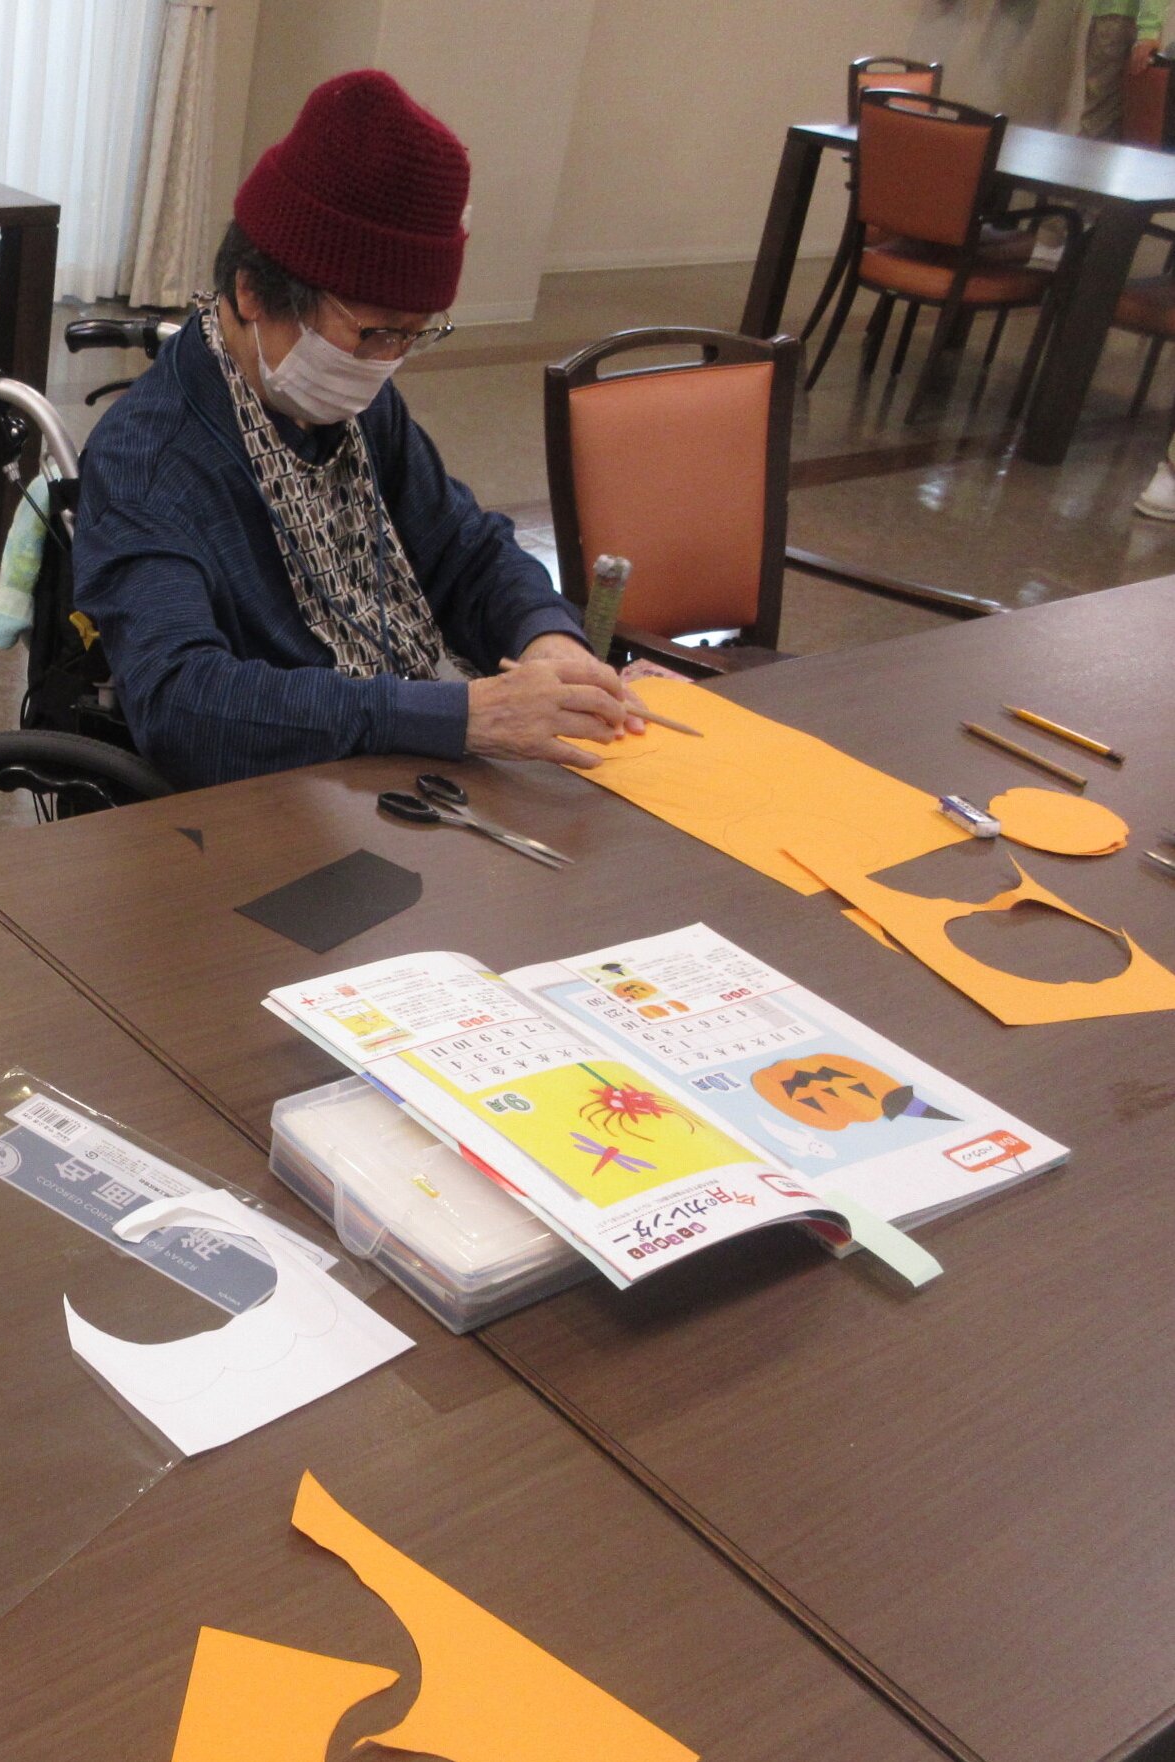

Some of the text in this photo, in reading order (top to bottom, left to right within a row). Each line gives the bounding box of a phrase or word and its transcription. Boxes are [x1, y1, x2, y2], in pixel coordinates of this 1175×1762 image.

[500, 1028, 515, 1037] 8
[524, 1024, 537, 1033] 7
[660, 1028, 674, 1037] 8
[679, 1024, 693, 1033] 7
[479, 1033, 493, 1043] 9
[642, 1032, 655, 1042] 9
[452, 1039, 473, 1050] 10
[659, 1040, 691, 1054] 1 2
[430, 1046, 449, 1058] 11
[450, 1041, 532, 1070] 1 2 3 4
[691, 1072, 742, 1091] 10月
[486, 1093, 531, 1113] 9月
[613, 1186, 756, 1243] 今月のカレンダー
